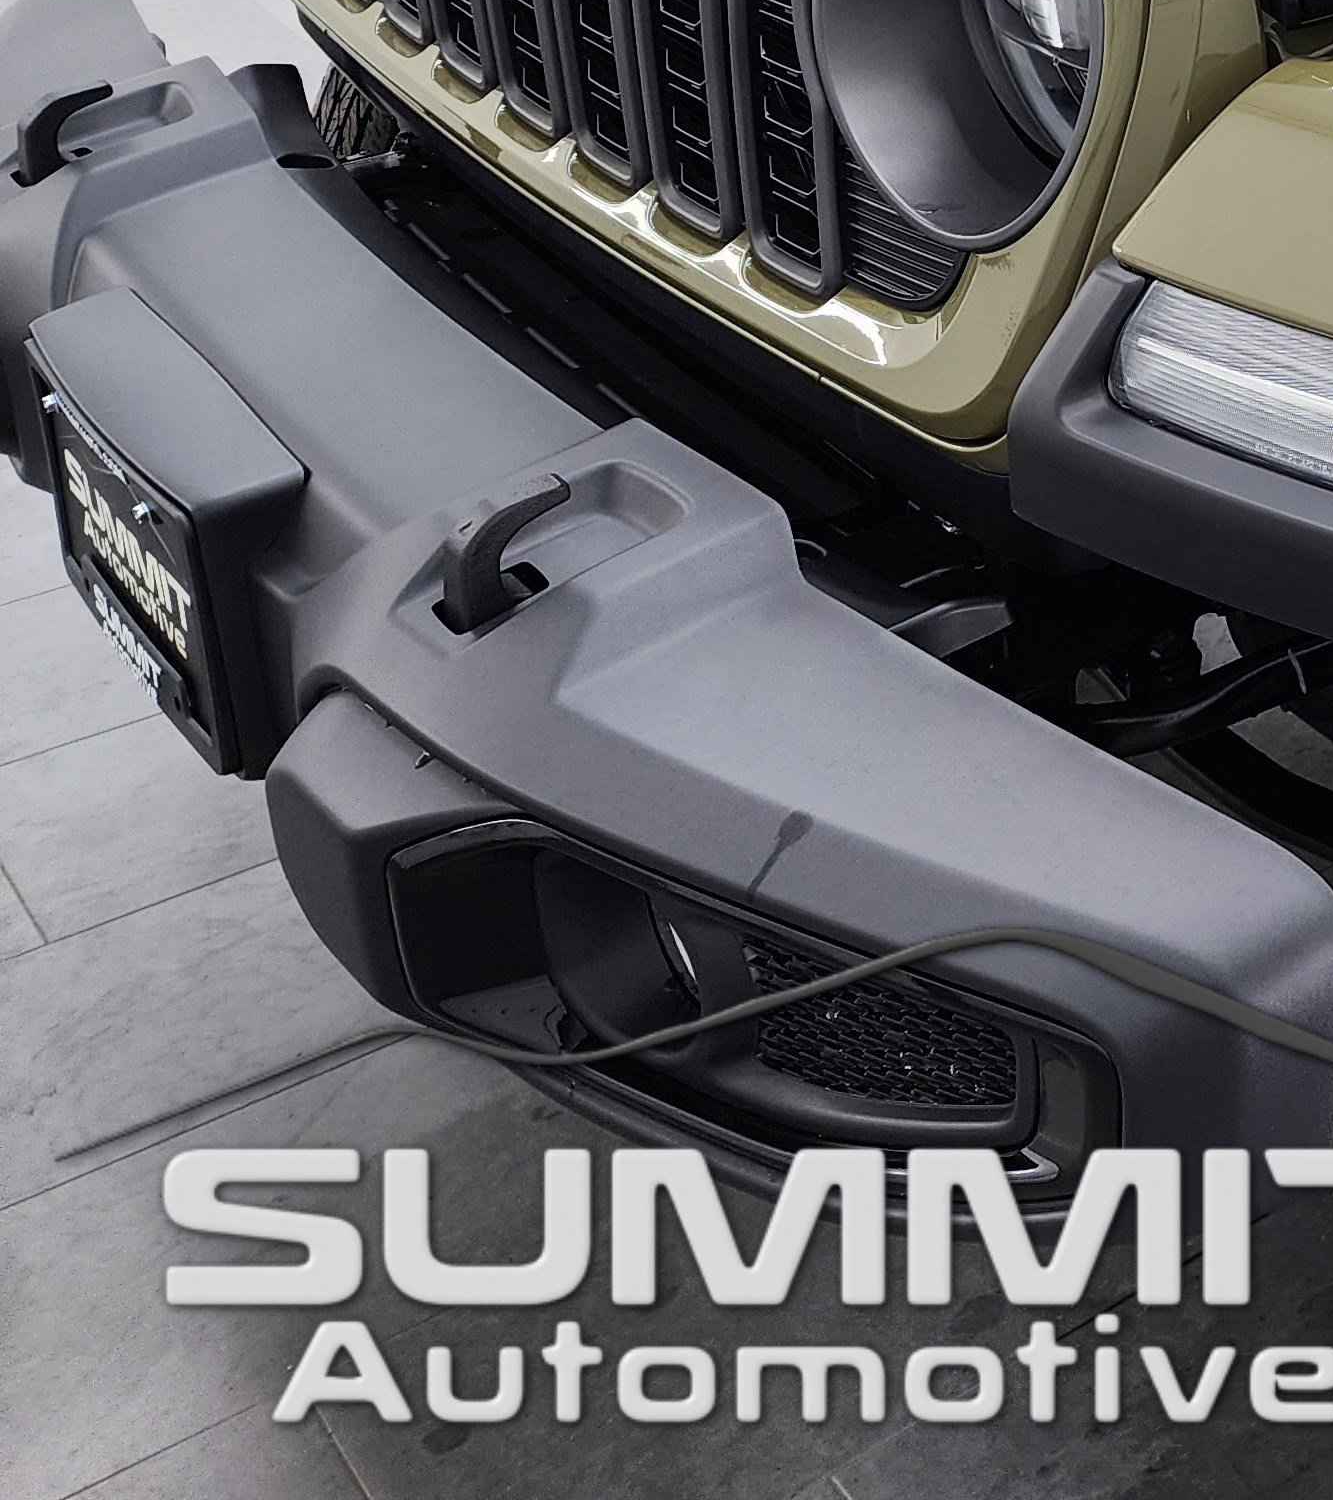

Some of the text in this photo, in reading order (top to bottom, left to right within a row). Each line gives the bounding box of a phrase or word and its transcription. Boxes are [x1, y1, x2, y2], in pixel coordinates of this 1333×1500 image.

[64, 448, 192, 632] SUMMIT
[82, 510, 188, 660] Automotive
[93, 583, 162, 689] SUMMIT
